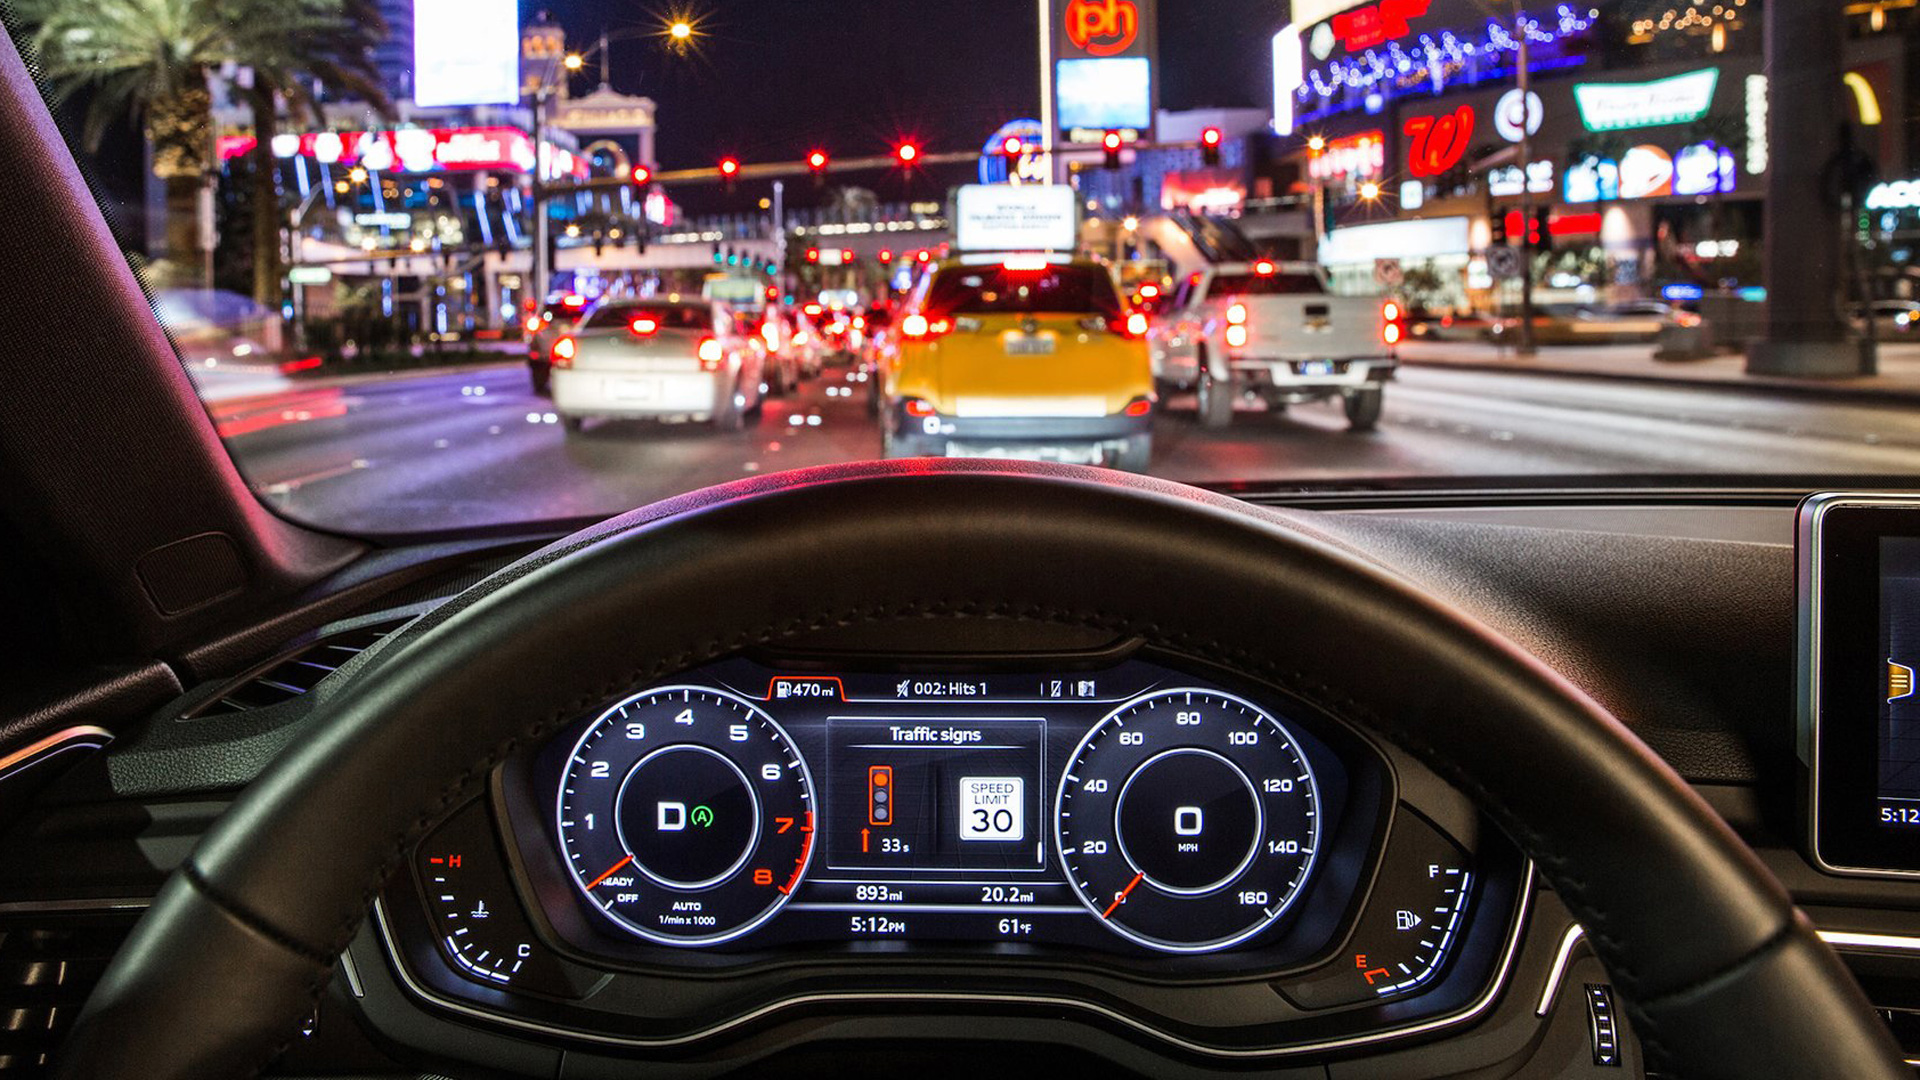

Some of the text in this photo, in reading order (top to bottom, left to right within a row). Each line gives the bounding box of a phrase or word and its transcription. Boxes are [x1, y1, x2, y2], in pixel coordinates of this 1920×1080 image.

[793, 683, 821, 697] 470
[914, 682, 987, 696] 002: Hits 1
[675, 708, 694, 725] 4
[1176, 712, 1201, 725] 80
[626, 723, 645, 740] 3
[729, 725, 749, 741] 5
[890, 726, 982, 743] Traffic signs
[1119, 732, 1144, 745] 60
[1228, 732, 1258, 745] 100
[591, 761, 610, 778] 2
[762, 764, 781, 781] 6
[971, 783, 1014, 794] SPEED
[1084, 779, 1108, 793] 40
[1263, 779, 1293, 792] 120
[974, 795, 1010, 805] LIMIT
[584, 813, 595, 830] 1
[657, 801, 687, 831] D
[971, 809, 1013, 832] 30
[1174, 806, 1203, 836] 0
[1881, 808, 1920, 824] 5:12
[775, 817, 794, 834] 7
[881, 838, 902, 852] 33
[1083, 841, 1107, 854] 20
[1178, 843, 1199, 853] MPH
[1269, 841, 1298, 854] 140
[448, 854, 462, 868] H
[753, 869, 773, 885] 8
[1428, 864, 1440, 878] F
[617, 893, 638, 903] OFF
[1238, 891, 1268, 904] 160
[672, 902, 701, 911] AUTO
[659, 914, 684, 926] 1/min
[693, 915, 716, 926] 1000
[518, 944, 531, 957] C
[1355, 954, 1367, 968] E
